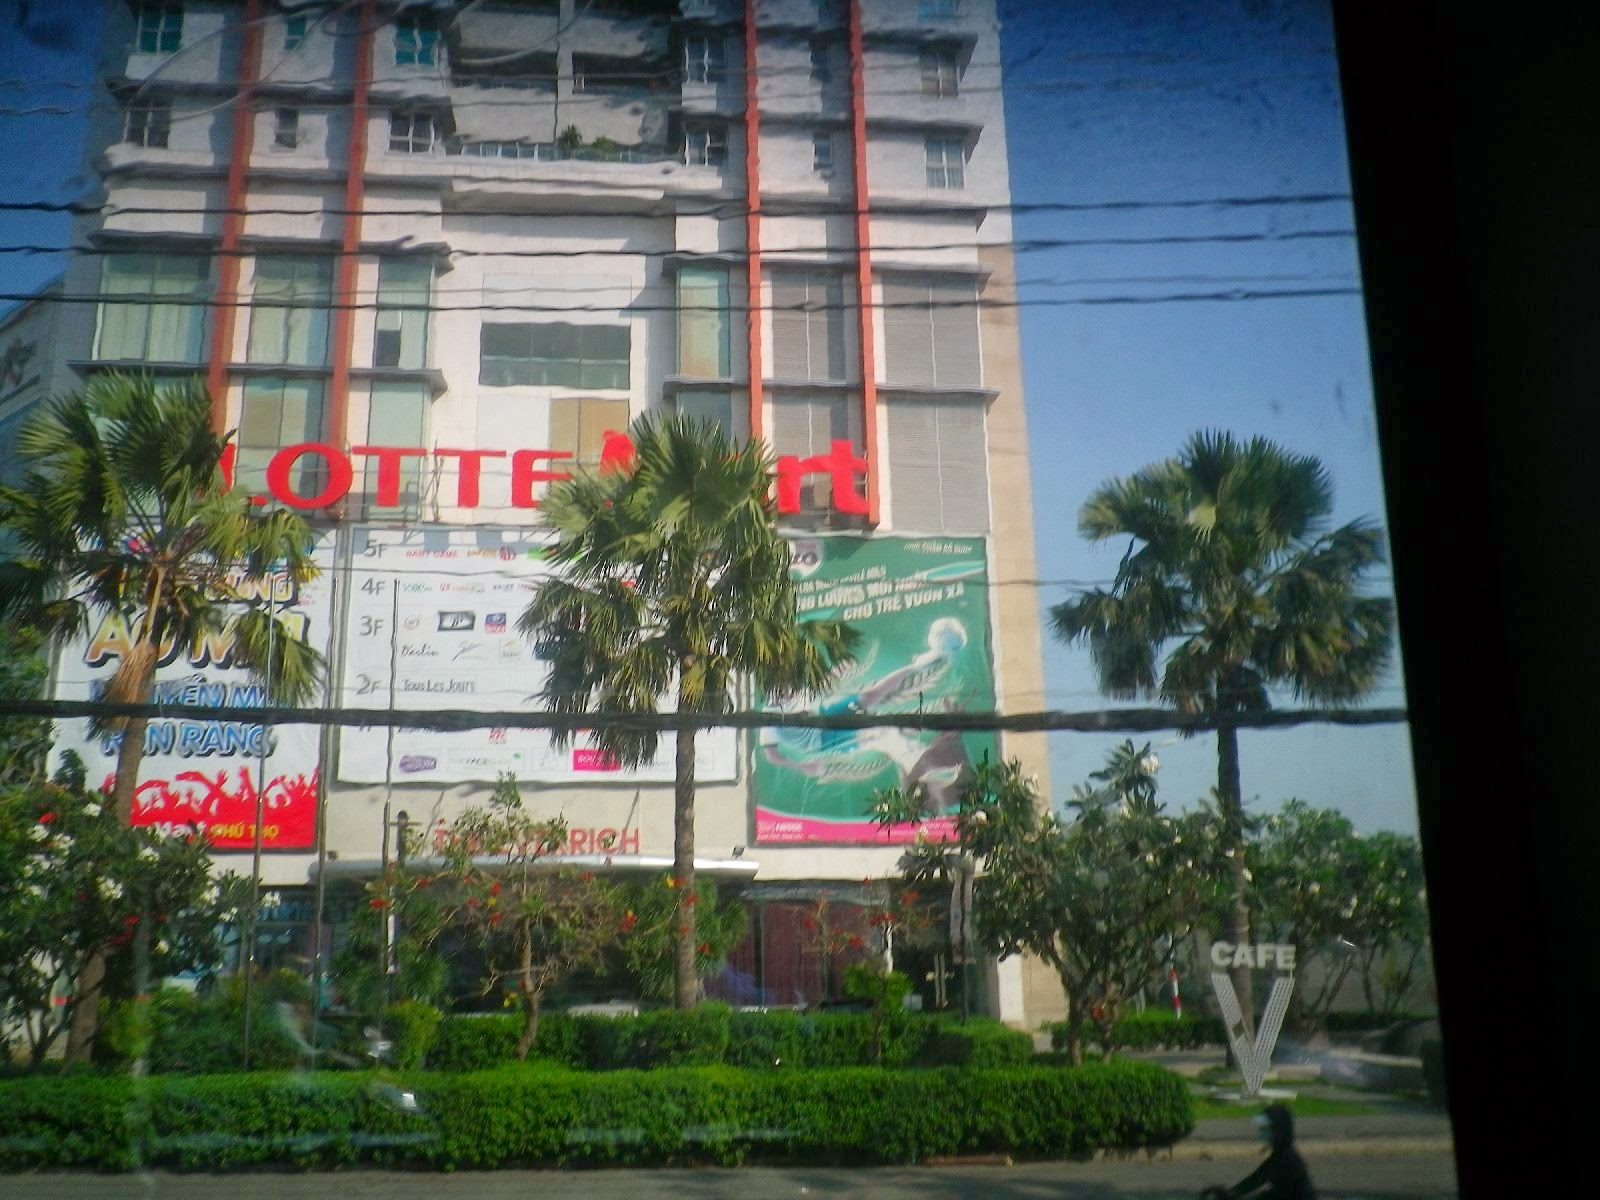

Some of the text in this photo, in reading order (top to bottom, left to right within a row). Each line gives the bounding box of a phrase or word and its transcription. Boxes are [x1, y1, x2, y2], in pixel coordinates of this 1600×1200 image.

[363, 539, 388, 558] 5F
[360, 577, 387, 596] 4F
[358, 615, 386, 637] 3F
[355, 674, 382, 696] 2F
[1211, 940, 1297, 970] CAFE
